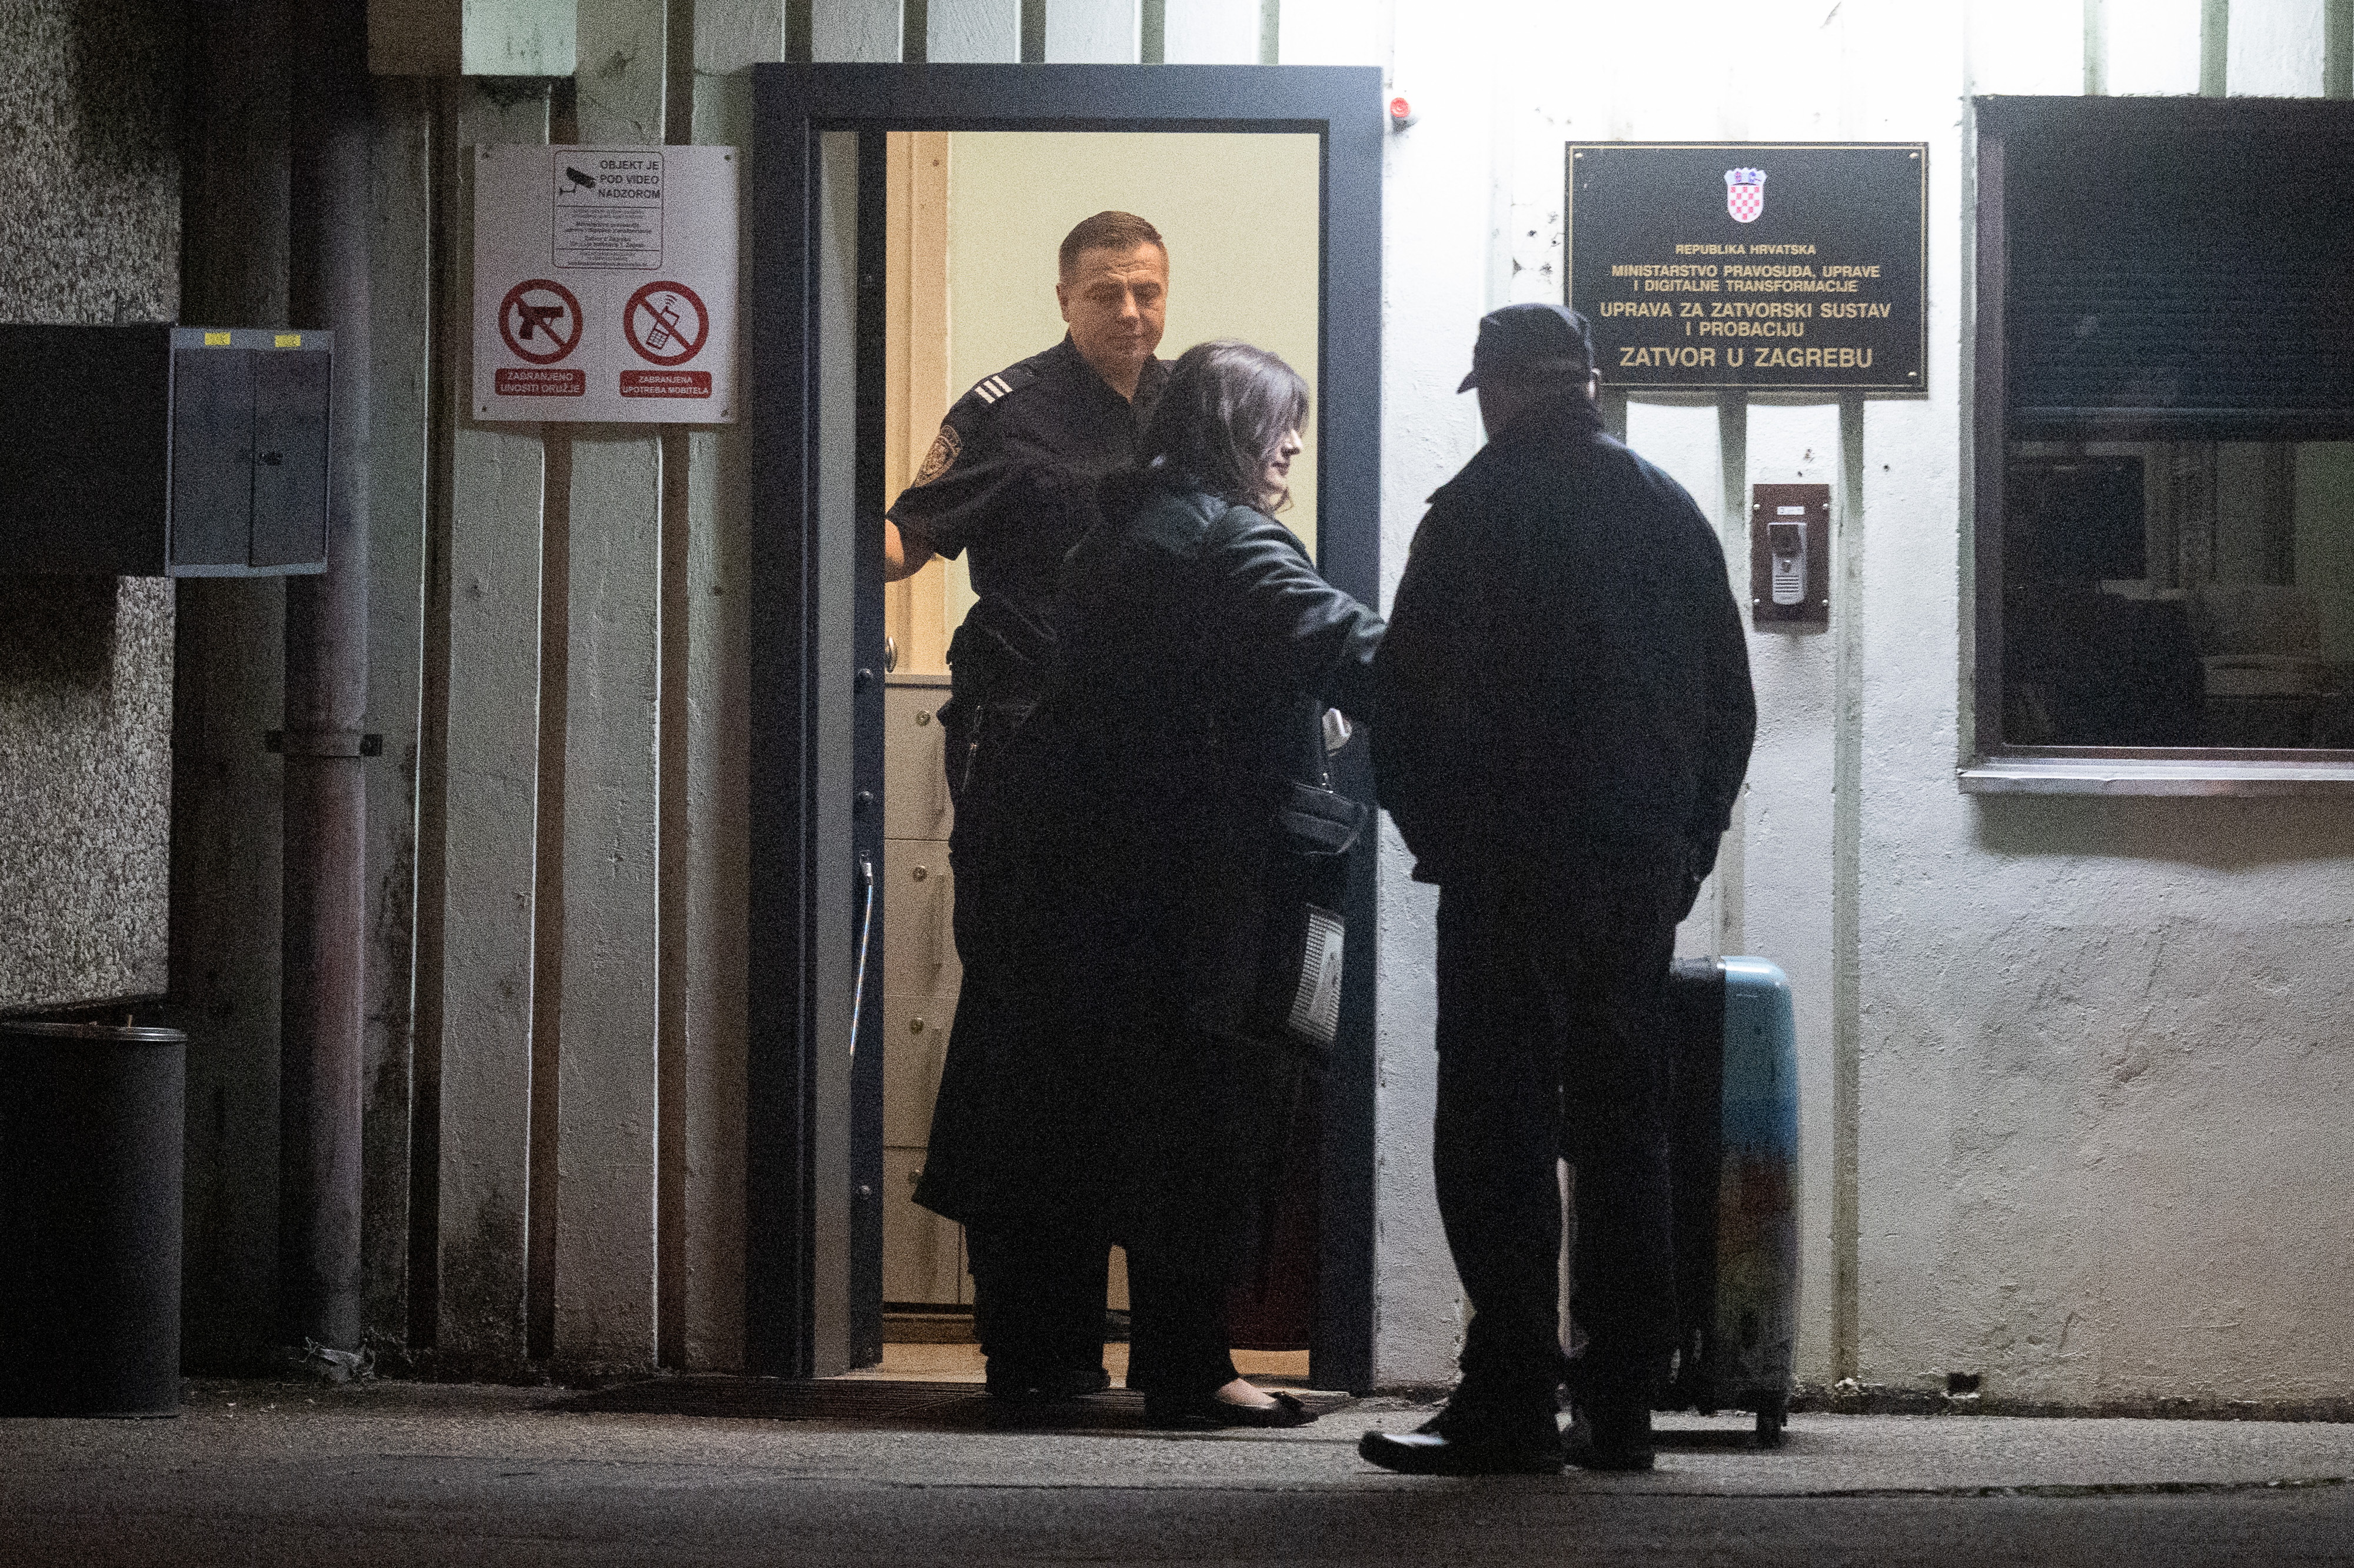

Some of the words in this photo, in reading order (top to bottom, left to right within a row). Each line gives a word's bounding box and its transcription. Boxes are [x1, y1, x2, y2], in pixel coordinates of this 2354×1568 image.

[600, 160, 644, 169] OBJEKT
[646, 161, 659, 170] JE
[600, 175, 623, 184] POD
[626, 175, 659, 184] VIDEO
[599, 188, 660, 199] NADZOROM
[1676, 245, 1745, 254] REPUBLIKA
[1750, 244, 1816, 255] HRVATSKA
[1611, 265, 1718, 277] MINISTARSTVO
[1823, 265, 1880, 278] UPRAVE
[1634, 280, 1638, 291] I
[1645, 279, 1719, 292] DIGITALNE
[1726, 279, 1858, 292] TRANSFORMACIJE
[1600, 302, 1673, 317] UPRAVA
[1680, 302, 1704, 317] ZA
[1711, 302, 1812, 318] ZATVORSKI
[1820, 302, 1891, 318] SUSTAV
[1686, 322, 1691, 335] I
[1700, 321, 1804, 337] PROBACIJU
[1620, 347, 1715, 367] ZATVOR
[1727, 348, 1744, 367] U
[1754, 348, 1873, 368] ZAGREBU
[507, 372, 573, 381] ZABRANJENO
[501, 384, 538, 392] UNOSITI
